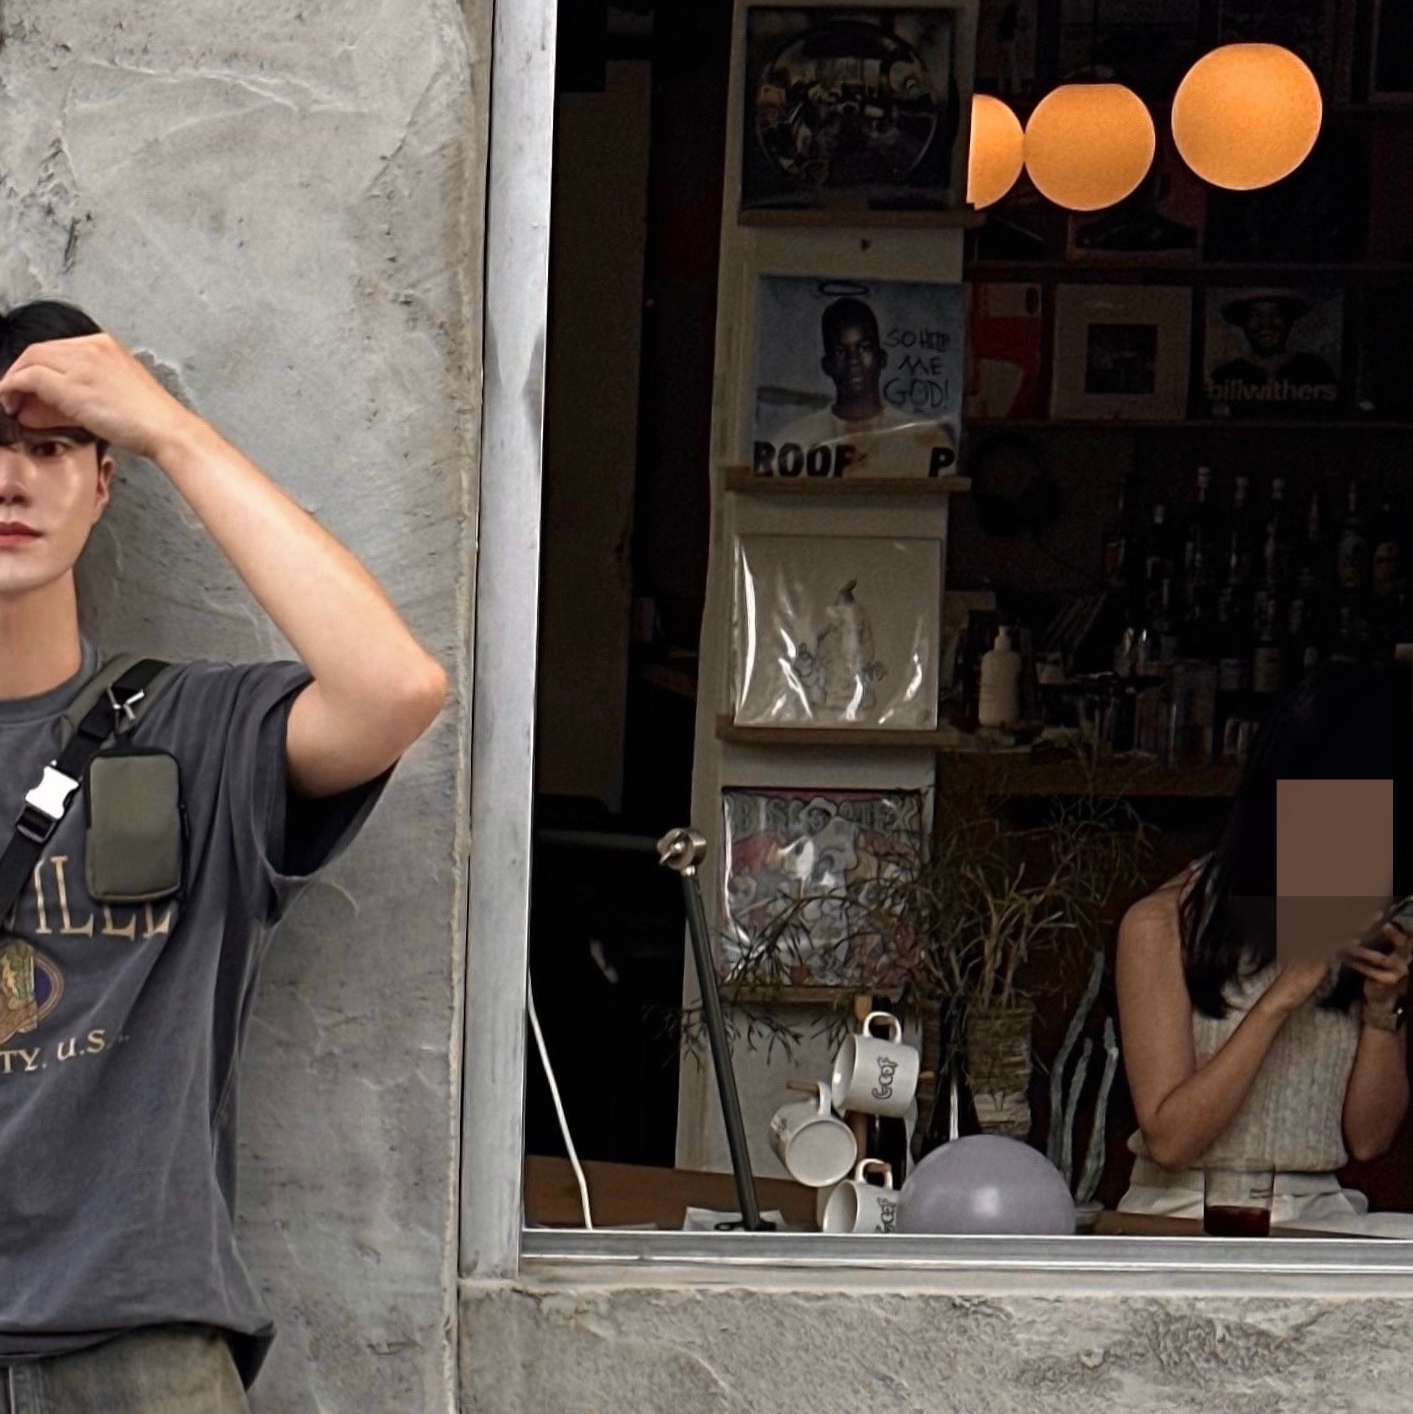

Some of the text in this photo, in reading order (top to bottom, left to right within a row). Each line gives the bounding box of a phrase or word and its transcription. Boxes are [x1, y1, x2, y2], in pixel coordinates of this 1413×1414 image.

[884, 328, 916, 348] SO
[898, 355, 943, 375] ME
[883, 377, 950, 410] GOD!
